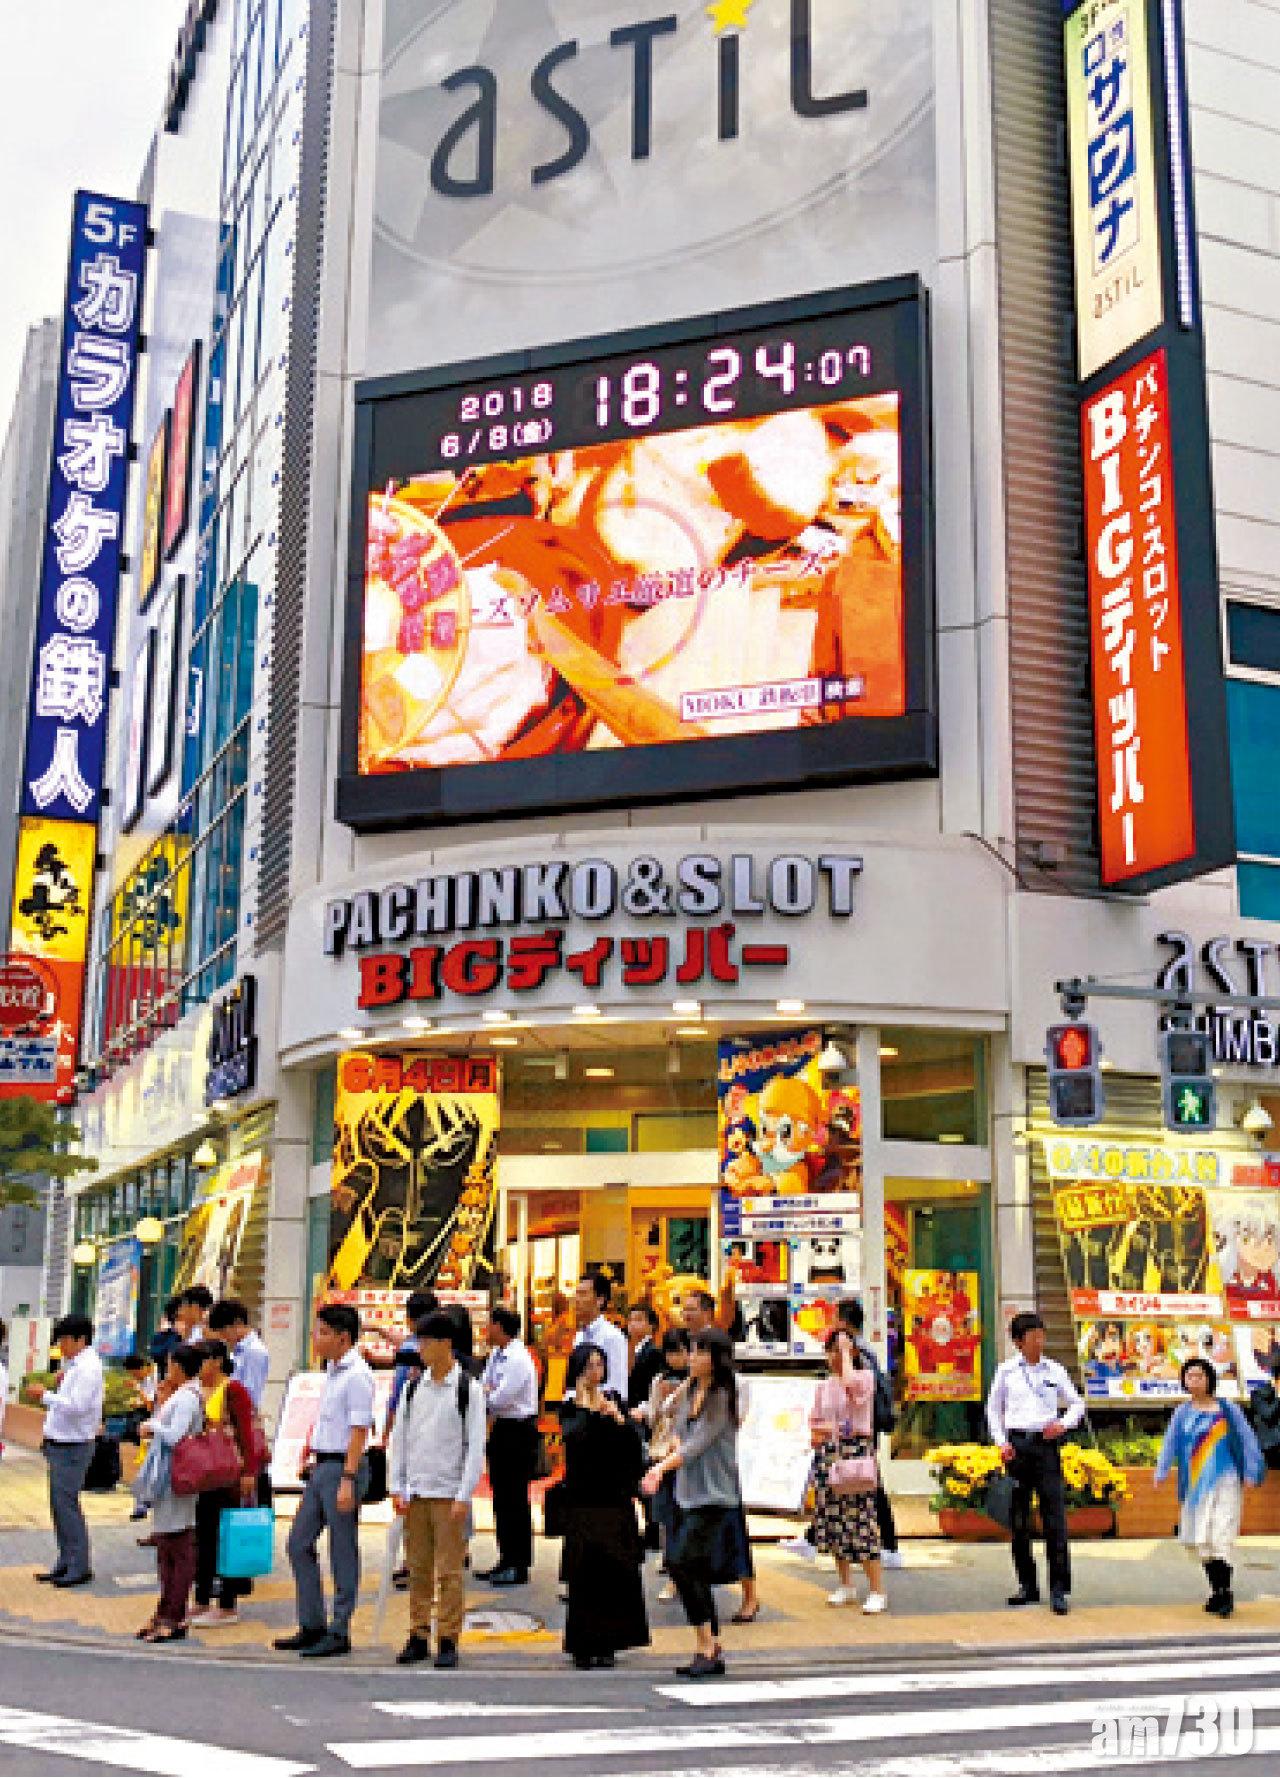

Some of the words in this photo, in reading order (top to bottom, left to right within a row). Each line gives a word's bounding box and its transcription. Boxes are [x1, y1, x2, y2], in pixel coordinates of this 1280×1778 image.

[82, 204, 137, 249] 5F
[460, 383, 553, 423] 2018
[29, 253, 138, 813] カラオケの鉄人
